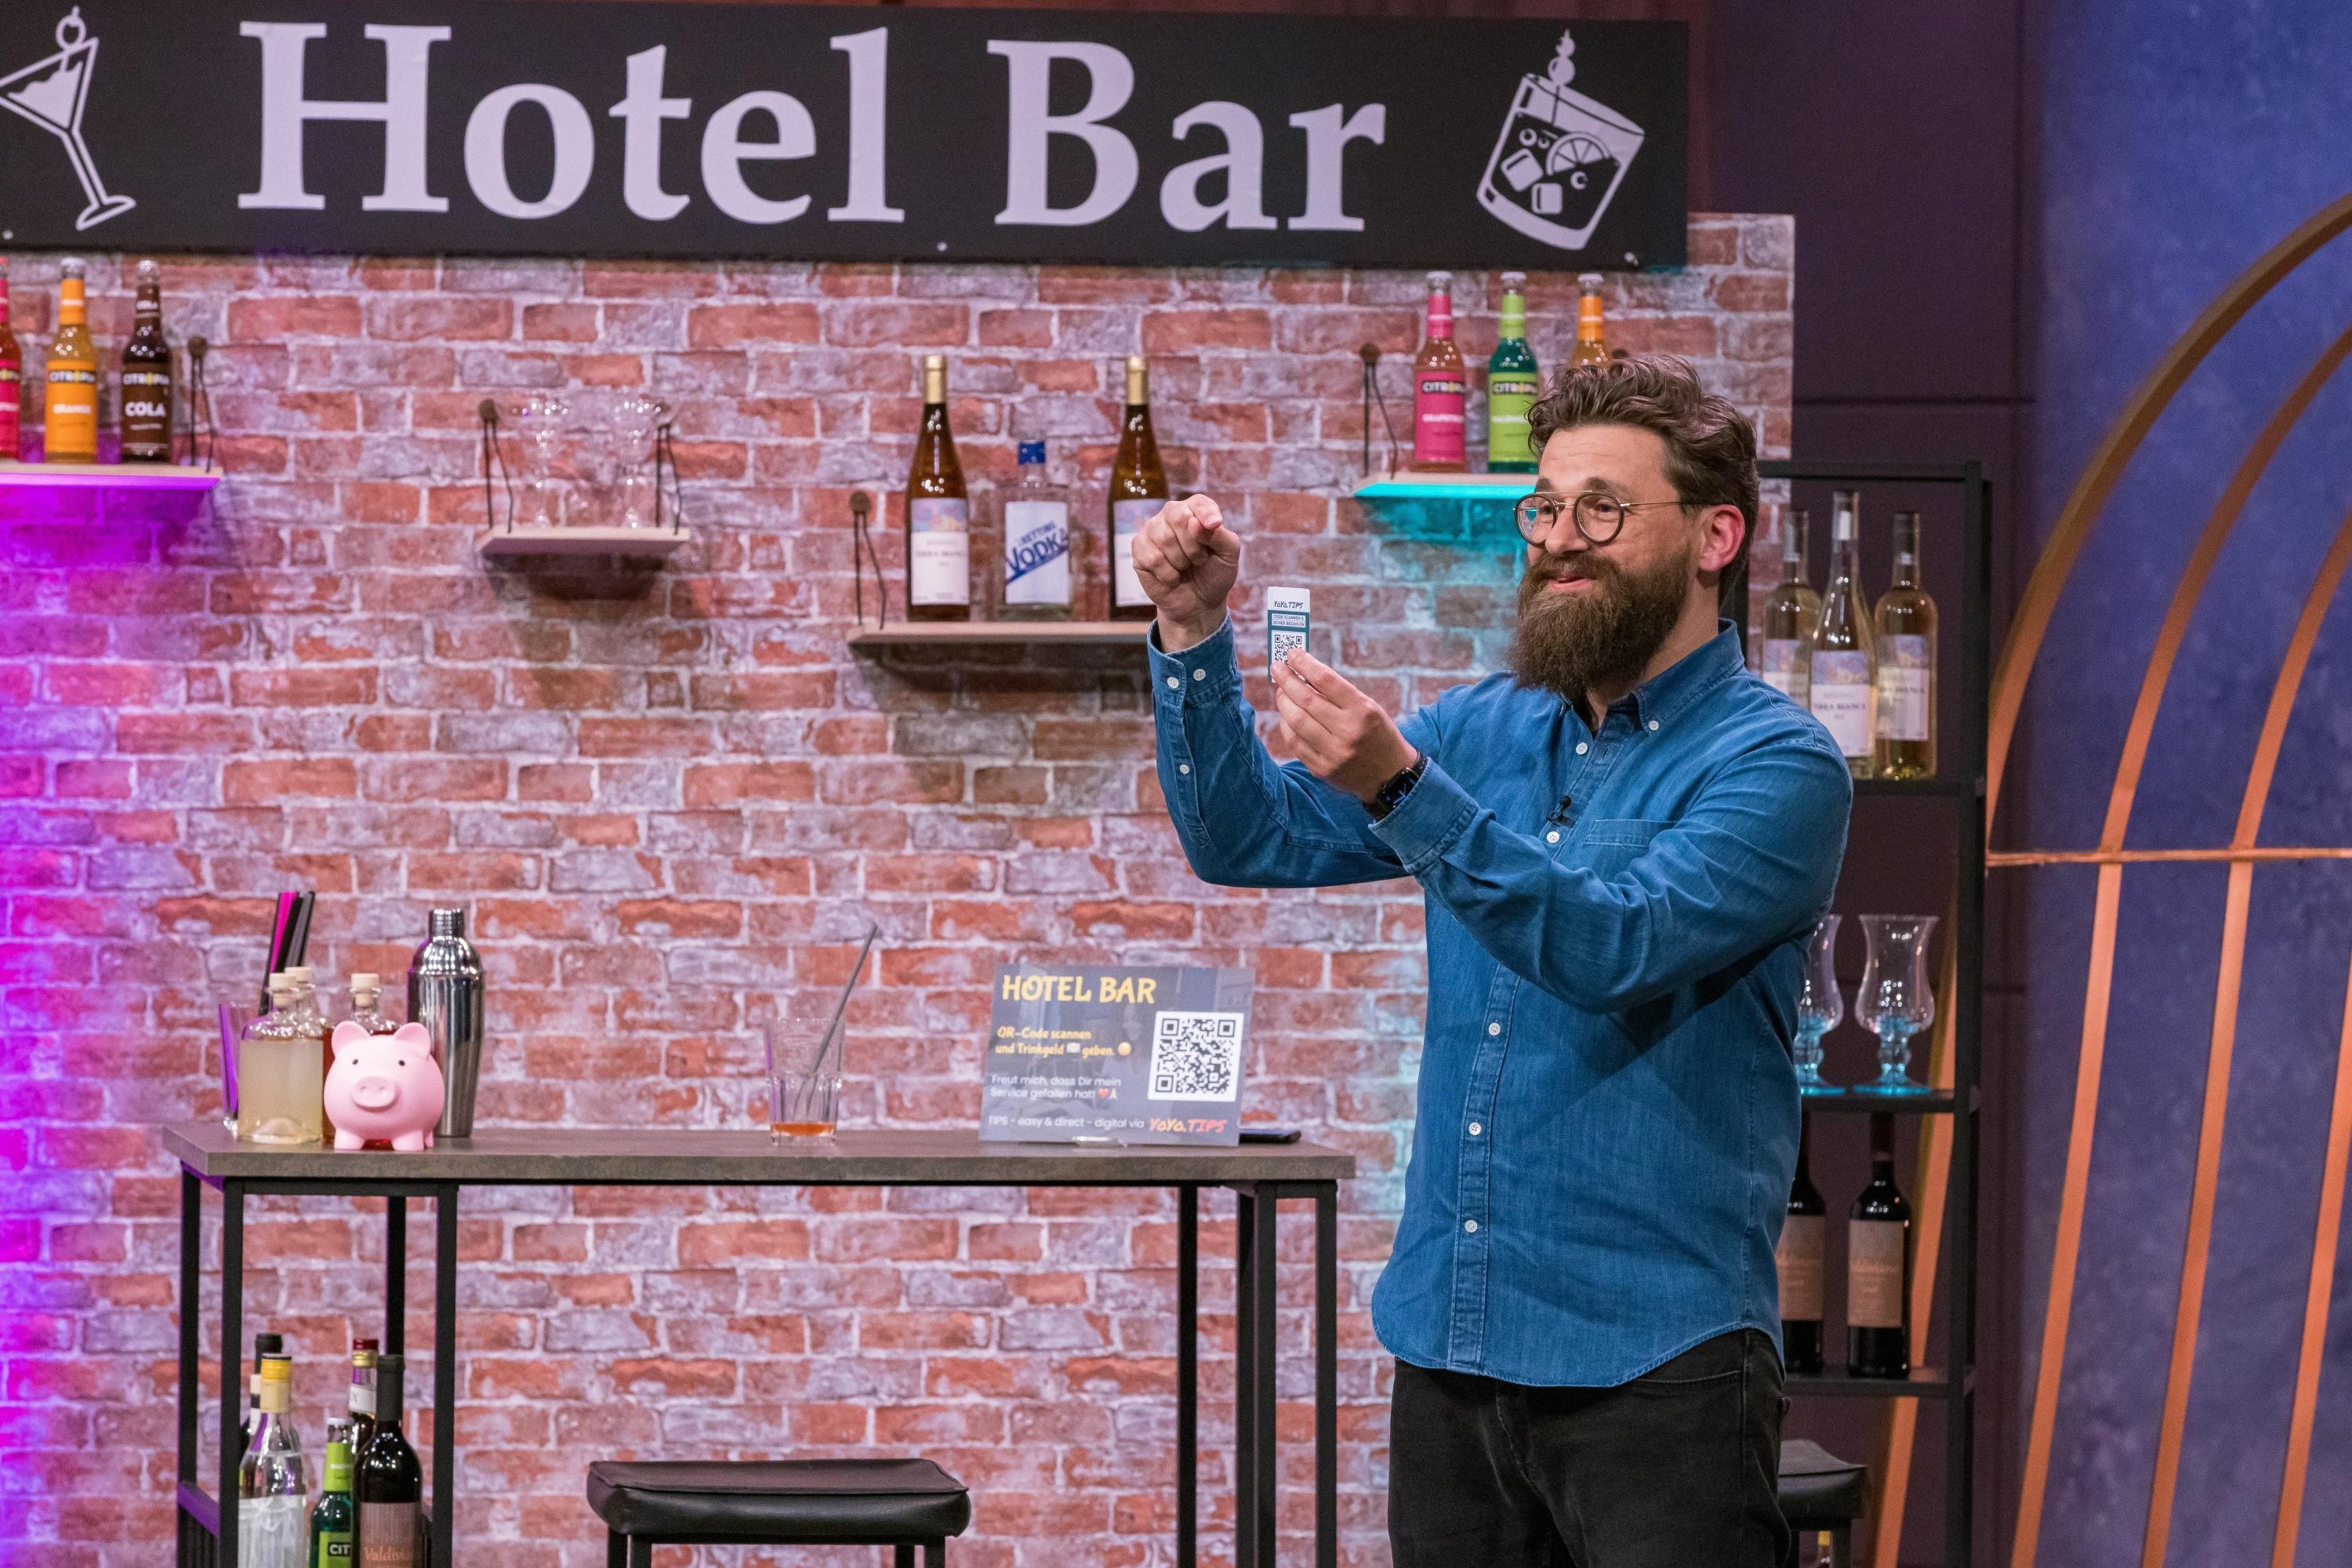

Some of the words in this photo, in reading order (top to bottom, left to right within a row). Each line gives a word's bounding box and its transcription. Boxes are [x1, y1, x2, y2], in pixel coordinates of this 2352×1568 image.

[238, 21, 904, 223] Hotel
[987, 40, 1385, 231] Bar
[125, 401, 166, 417] COLA
[1003, 975, 1092, 1002] HOTEL
[1099, 976, 1156, 1004] BAR
[996, 1026, 1049, 1040] QR-Code
[1051, 1029, 1092, 1040] scannen
[995, 1043, 1014, 1054] und
[1017, 1042, 1065, 1058] Trinkgeld
[992, 1075, 1018, 1086] Freut
[1051, 1076, 1076, 1087] dass
[1078, 1076, 1093, 1087] Dir
[1094, 1077, 1122, 1087] mein
[990, 1087, 1029, 1098] Service
[1030, 1087, 1072, 1101] gefallen
[989, 1115, 1009, 1126] TIPS
[1018, 1116, 1044, 1128] easy
[1044, 1116, 1053, 1127] &
[1054, 1116, 1084, 1127] direct
[1094, 1118, 1127, 1131] digital
[1128, 1120, 1145, 1129] via
